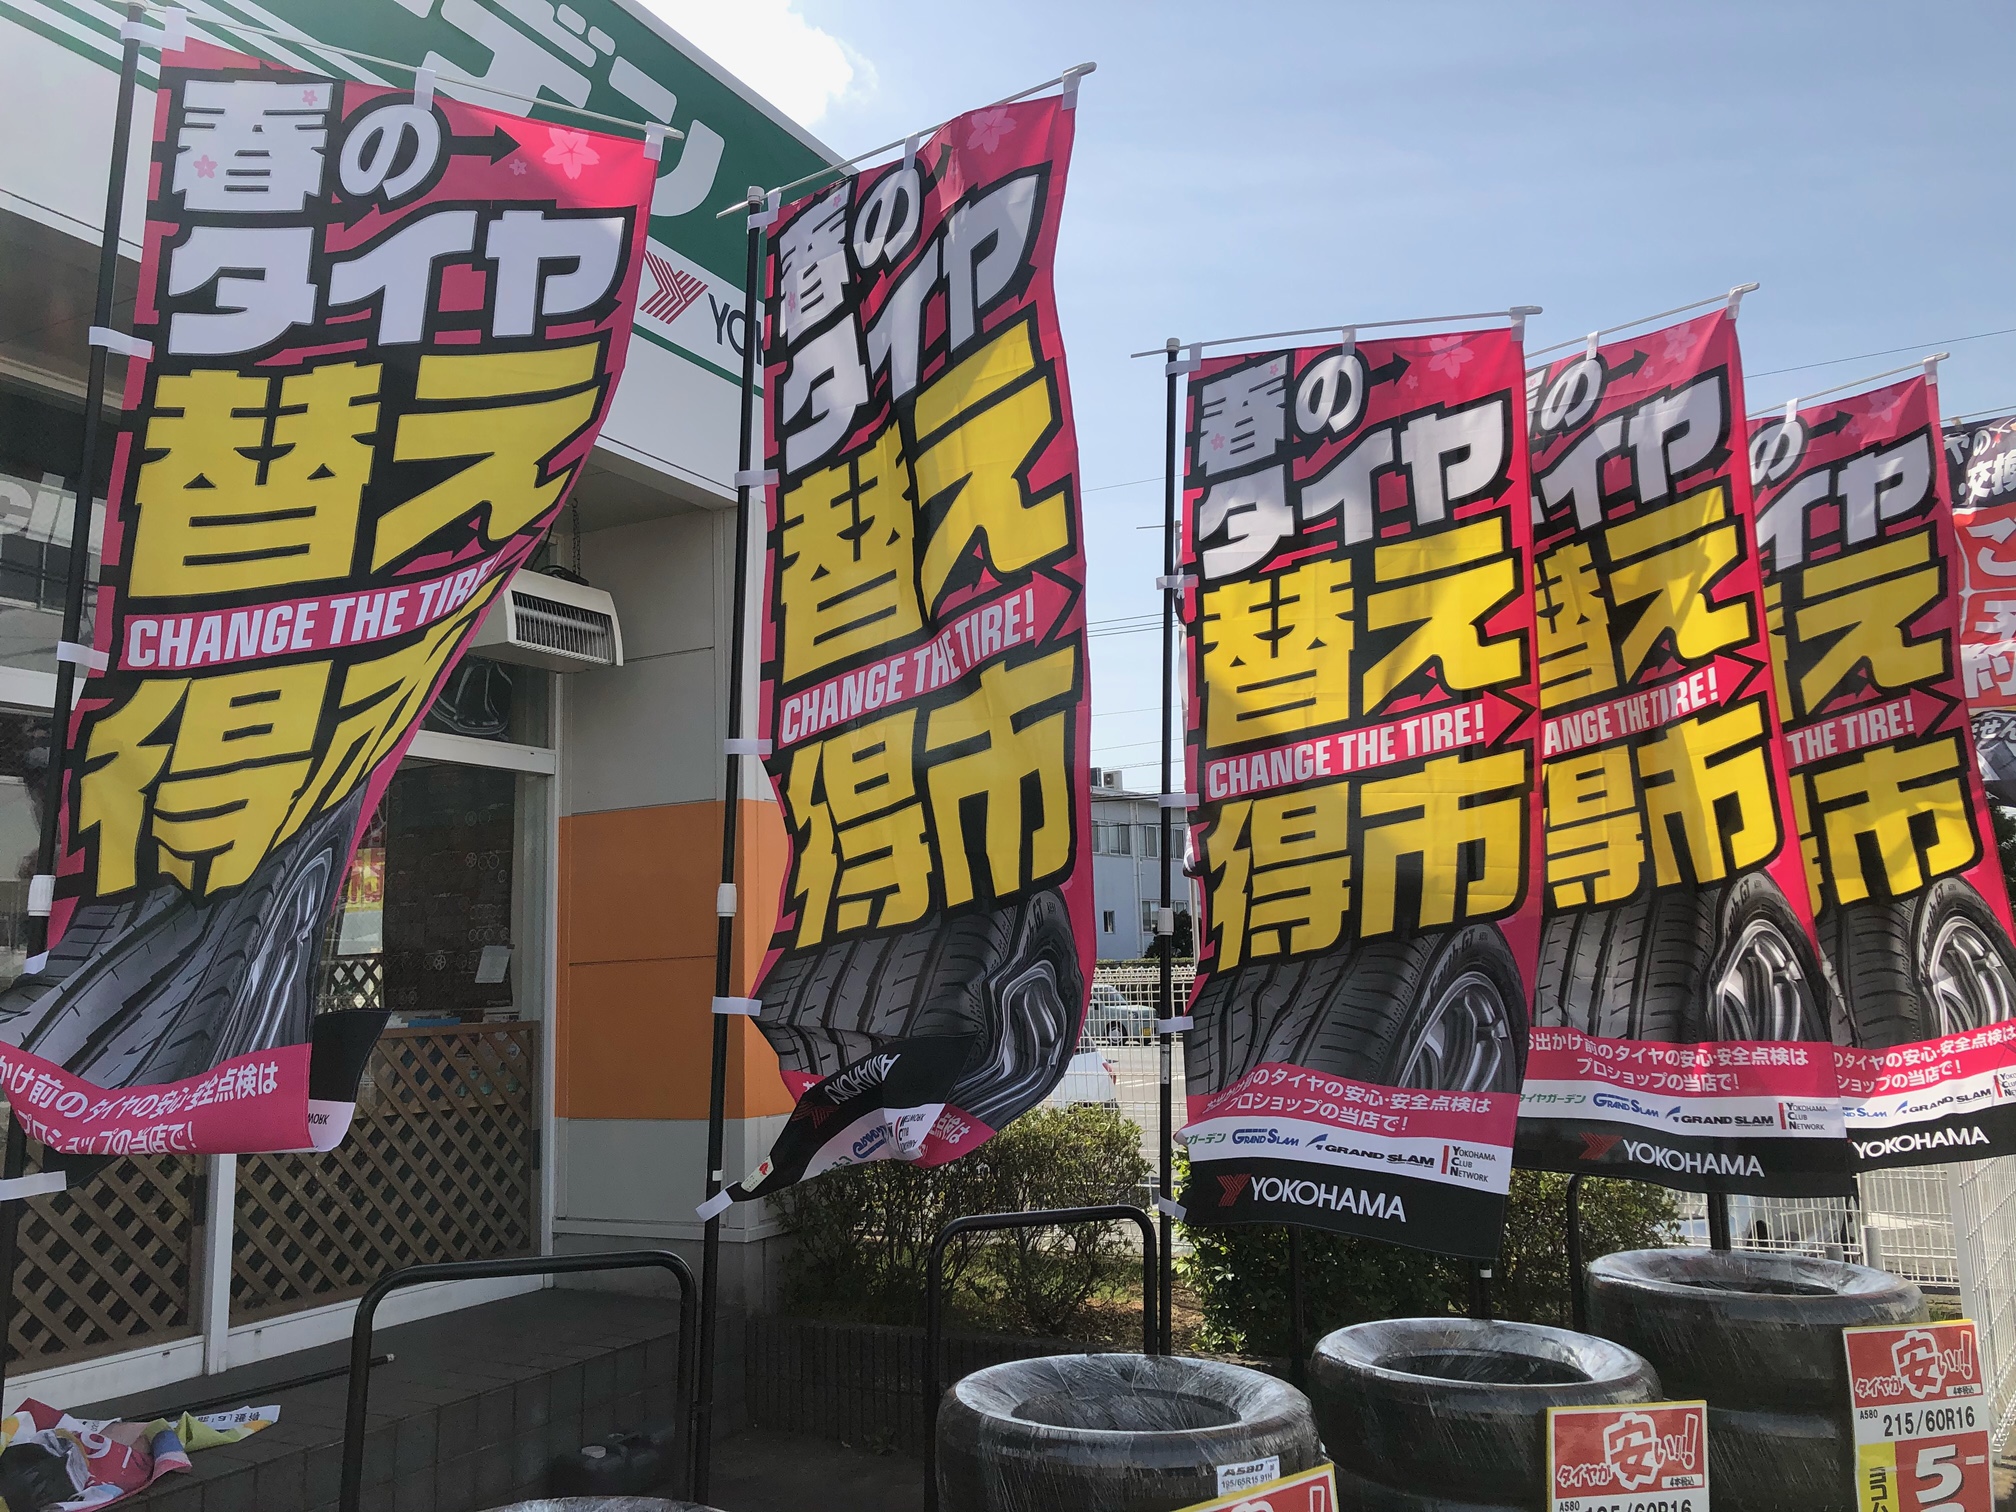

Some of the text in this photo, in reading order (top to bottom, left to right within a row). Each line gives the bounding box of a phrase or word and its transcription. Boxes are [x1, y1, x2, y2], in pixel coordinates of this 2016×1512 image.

[172, 79, 441, 212] 春の
[168, 209, 626, 357] タイヤ
[779, 167, 922, 340] 春の
[782, 173, 1040, 475] タイヤ
[1198, 353, 1363, 476] 春の
[1531, 375, 1722, 530] イヤ
[127, 341, 600, 598] 替え
[780, 320, 1070, 685] 替え
[1199, 399, 1504, 580] タイヤ
[127, 603, 319, 667] CHANGE
[328, 589, 411, 644] THE
[779, 589, 1035, 745] CHANGE THE TIRE!
[1203, 516, 1522, 749] 替え
[1208, 704, 1484, 799] CHANGE THE TIRE!
[1544, 667, 1719, 756] ANGE THE TIRE!
[1787, 699, 1914, 764] THE TIRE!
[787, 645, 1075, 950] 得市
[1206, 750, 1525, 971] 得市
[1681, 1115, 1774, 1125] GRAND SLAM
[1852, 1126, 1990, 1159] YOKOHAMA
[1909, 1096, 1953, 1113] GRAND
[1956, 1089, 1991, 1103] SLAM
[1324, 1145, 1384, 1159] GRAND
[1387, 1153, 1435, 1166] SLAM
[1450, 1166, 1489, 1182] NETWORK
[1451, 1157, 1473, 1168] CLUB
[1452, 1145, 1496, 1161] YOKOHAMA
[1623, 1139, 1765, 1178] YOKOHAMA
[1250, 1175, 1407, 1223] YOKOHAMA
[1860, 1409, 1878, 1420] A580
[1883, 1406, 1975, 1437] 215/60R16
[1559, 1501, 1580, 1512] A580
